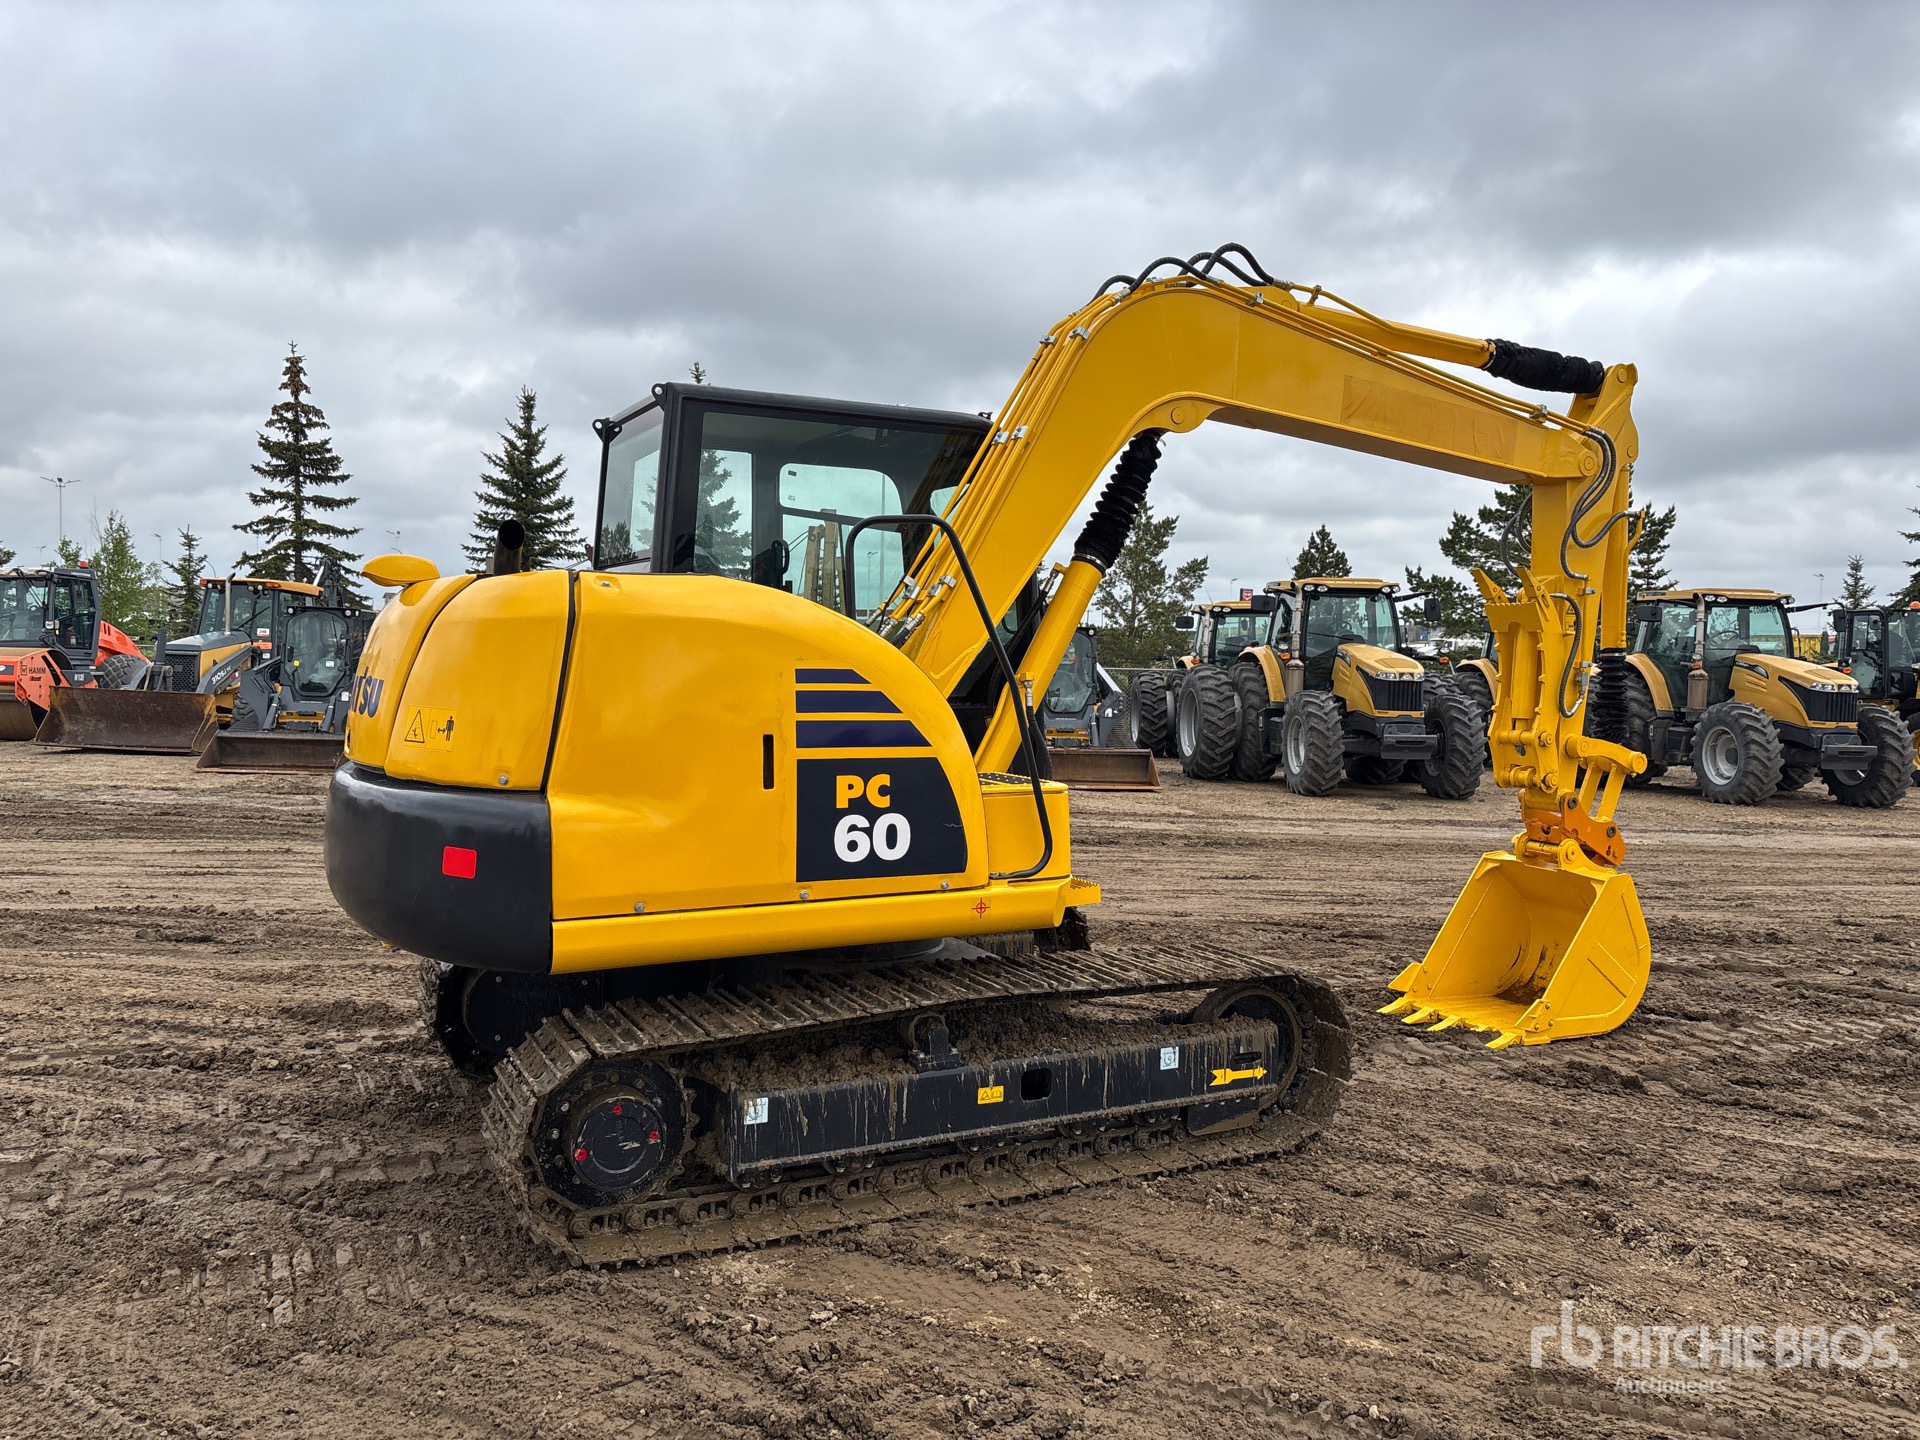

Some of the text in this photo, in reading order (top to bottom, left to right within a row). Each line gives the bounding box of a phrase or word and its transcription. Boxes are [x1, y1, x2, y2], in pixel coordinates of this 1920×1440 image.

[28, 666, 47, 675] HAMM
[211, 668, 227, 685] 310SJ
[351, 666, 385, 718] TSU
[836, 773, 891, 809] PC
[834, 812, 911, 863] 60
